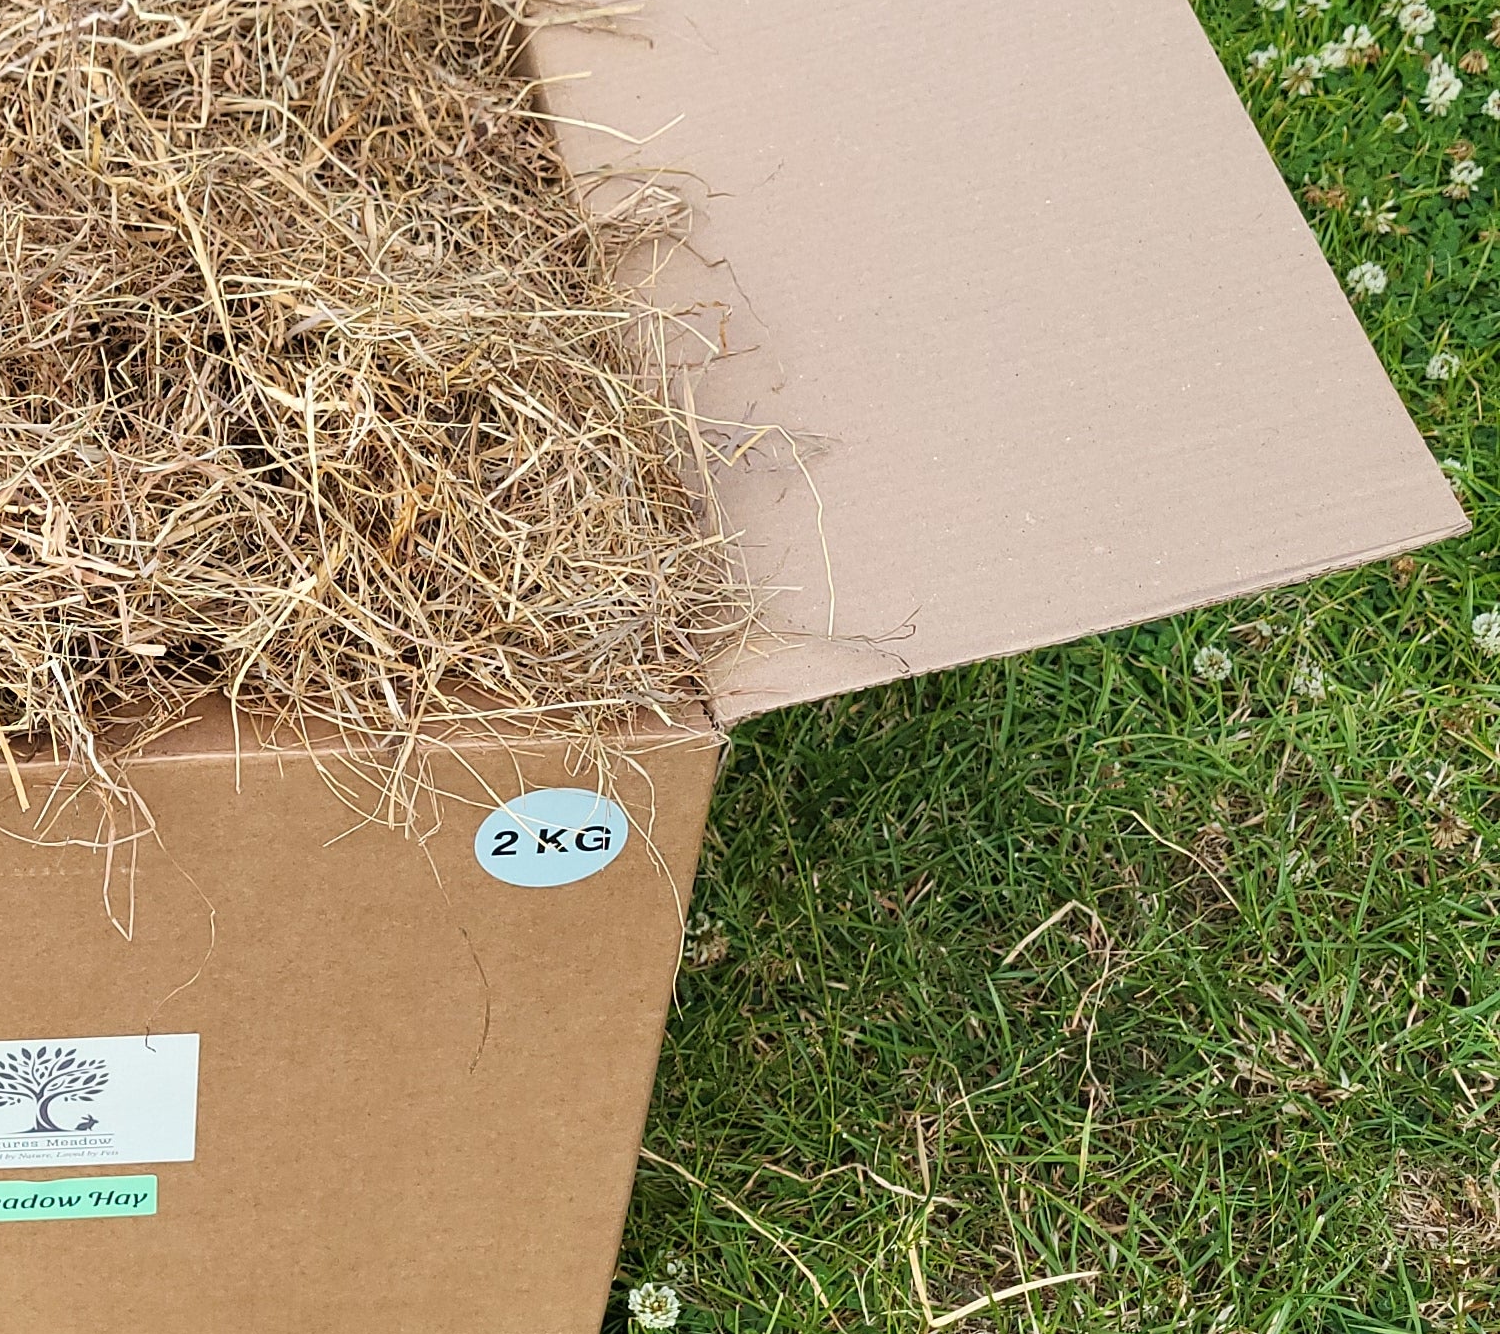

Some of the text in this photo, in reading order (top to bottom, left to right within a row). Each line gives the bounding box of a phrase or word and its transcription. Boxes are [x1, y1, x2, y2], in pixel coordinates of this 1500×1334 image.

[490, 825, 612, 856] 2 KG
[46, 1137, 113, 1147] Meadow
[88, 1188, 149, 1209] Hay
